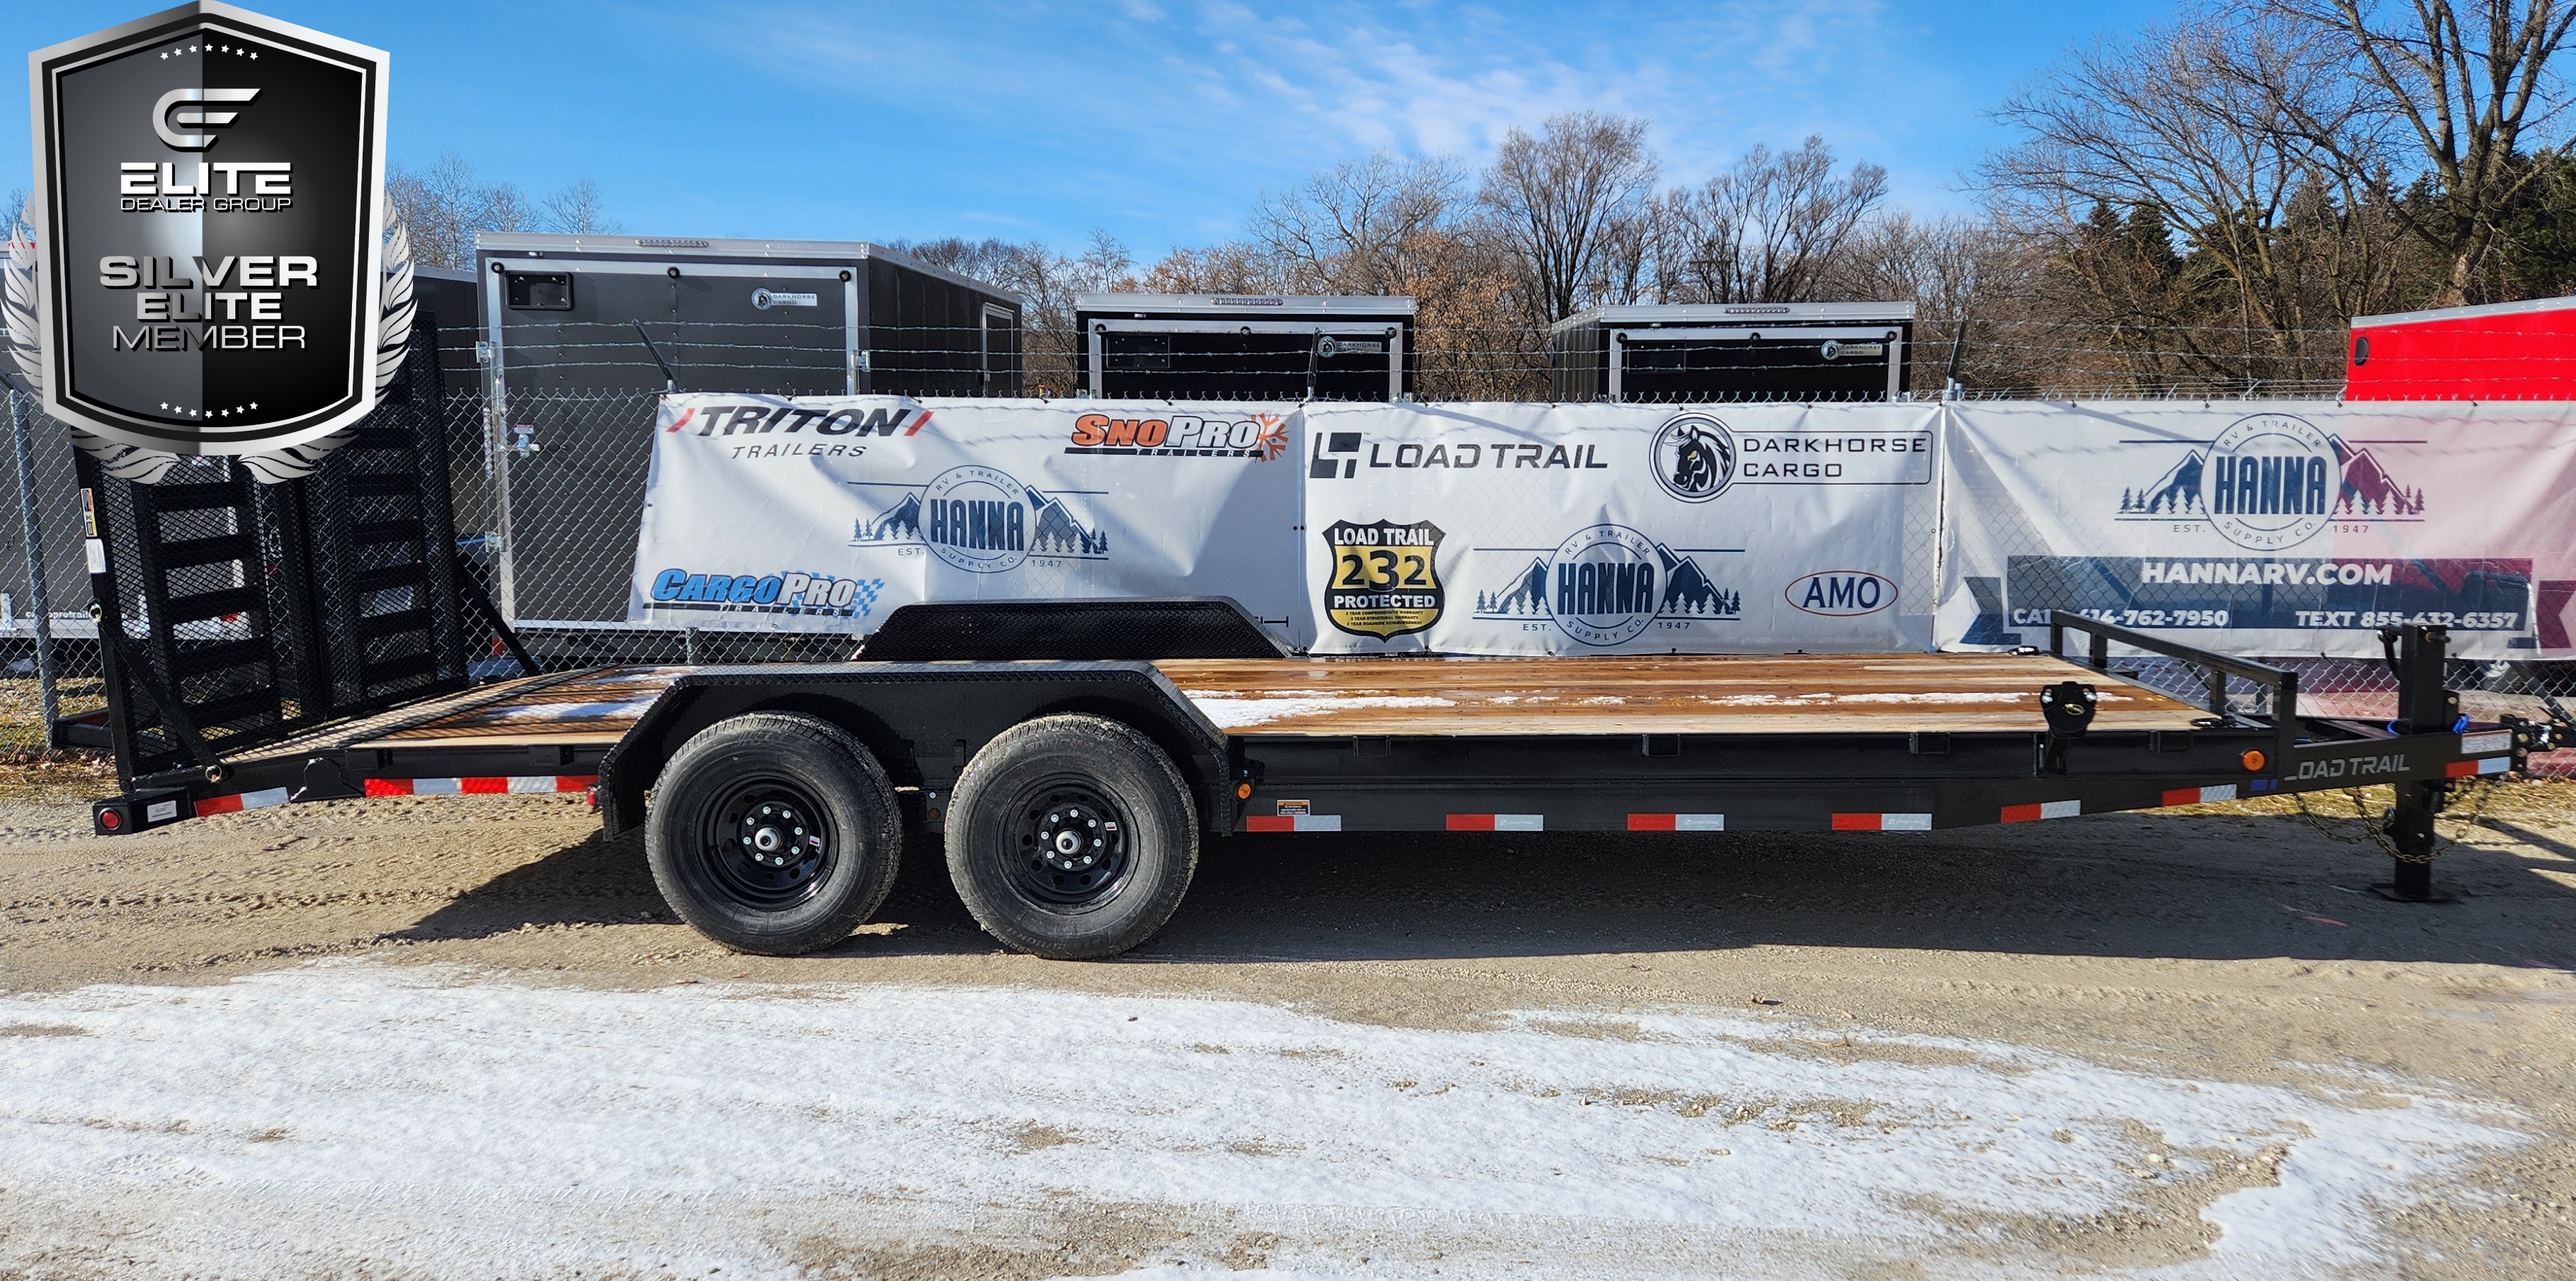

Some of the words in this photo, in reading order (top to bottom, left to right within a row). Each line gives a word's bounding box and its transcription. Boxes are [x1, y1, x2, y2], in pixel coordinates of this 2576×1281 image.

[697, 406, 912, 436] TRITON
[2223, 431, 2239, 446] RV
[2262, 419, 2321, 447] TRAILER
[732, 443, 867, 460] TRAILERS
[1136, 448, 1251, 457] TRAILERS
[1369, 444, 1482, 468] LOAD
[1490, 444, 1608, 468] TRAIL
[1744, 438, 1927, 453] DARKHORSE
[1744, 463, 1842, 478] CARGO
[936, 478, 949, 492] RV
[969, 470, 1019, 495] TRAILER
[2214, 456, 2327, 514] HANNA
[930, 498, 1024, 551] HANNA
[2173, 524, 2206, 533] EST.
[2223, 521, 2283, 544] SUPPLY
[2295, 521, 2316, 537] CO.
[1334, 528, 1380, 546] LOAD
[1383, 528, 1434, 546] TRAIL
[1565, 541, 1579, 555] RV
[1599, 530, 1650, 555] TRAILER
[897, 548, 926, 556] EST.
[940, 548, 992, 569] SUPPLY
[1000, 555, 1018, 568] CO.
[1341, 550, 1427, 592] 232
[2143, 562, 2393, 585] HANNARV.COM
[1557, 562, 1655, 615] HANNA
[1803, 576, 1880, 609] AMO
[719, 604, 841, 616] TRAILERS
[1334, 594, 1436, 608] PROTECTED
[1566, 620, 1619, 640] SUPPLY
[1626, 619, 1645, 633] CO.
[2296, 611, 2356, 627] TEXT
[2360, 611, 2519, 628] 855-432-6357
[2285, 760, 2345, 780] OAD
[2349, 754, 2410, 775] TRAIL
